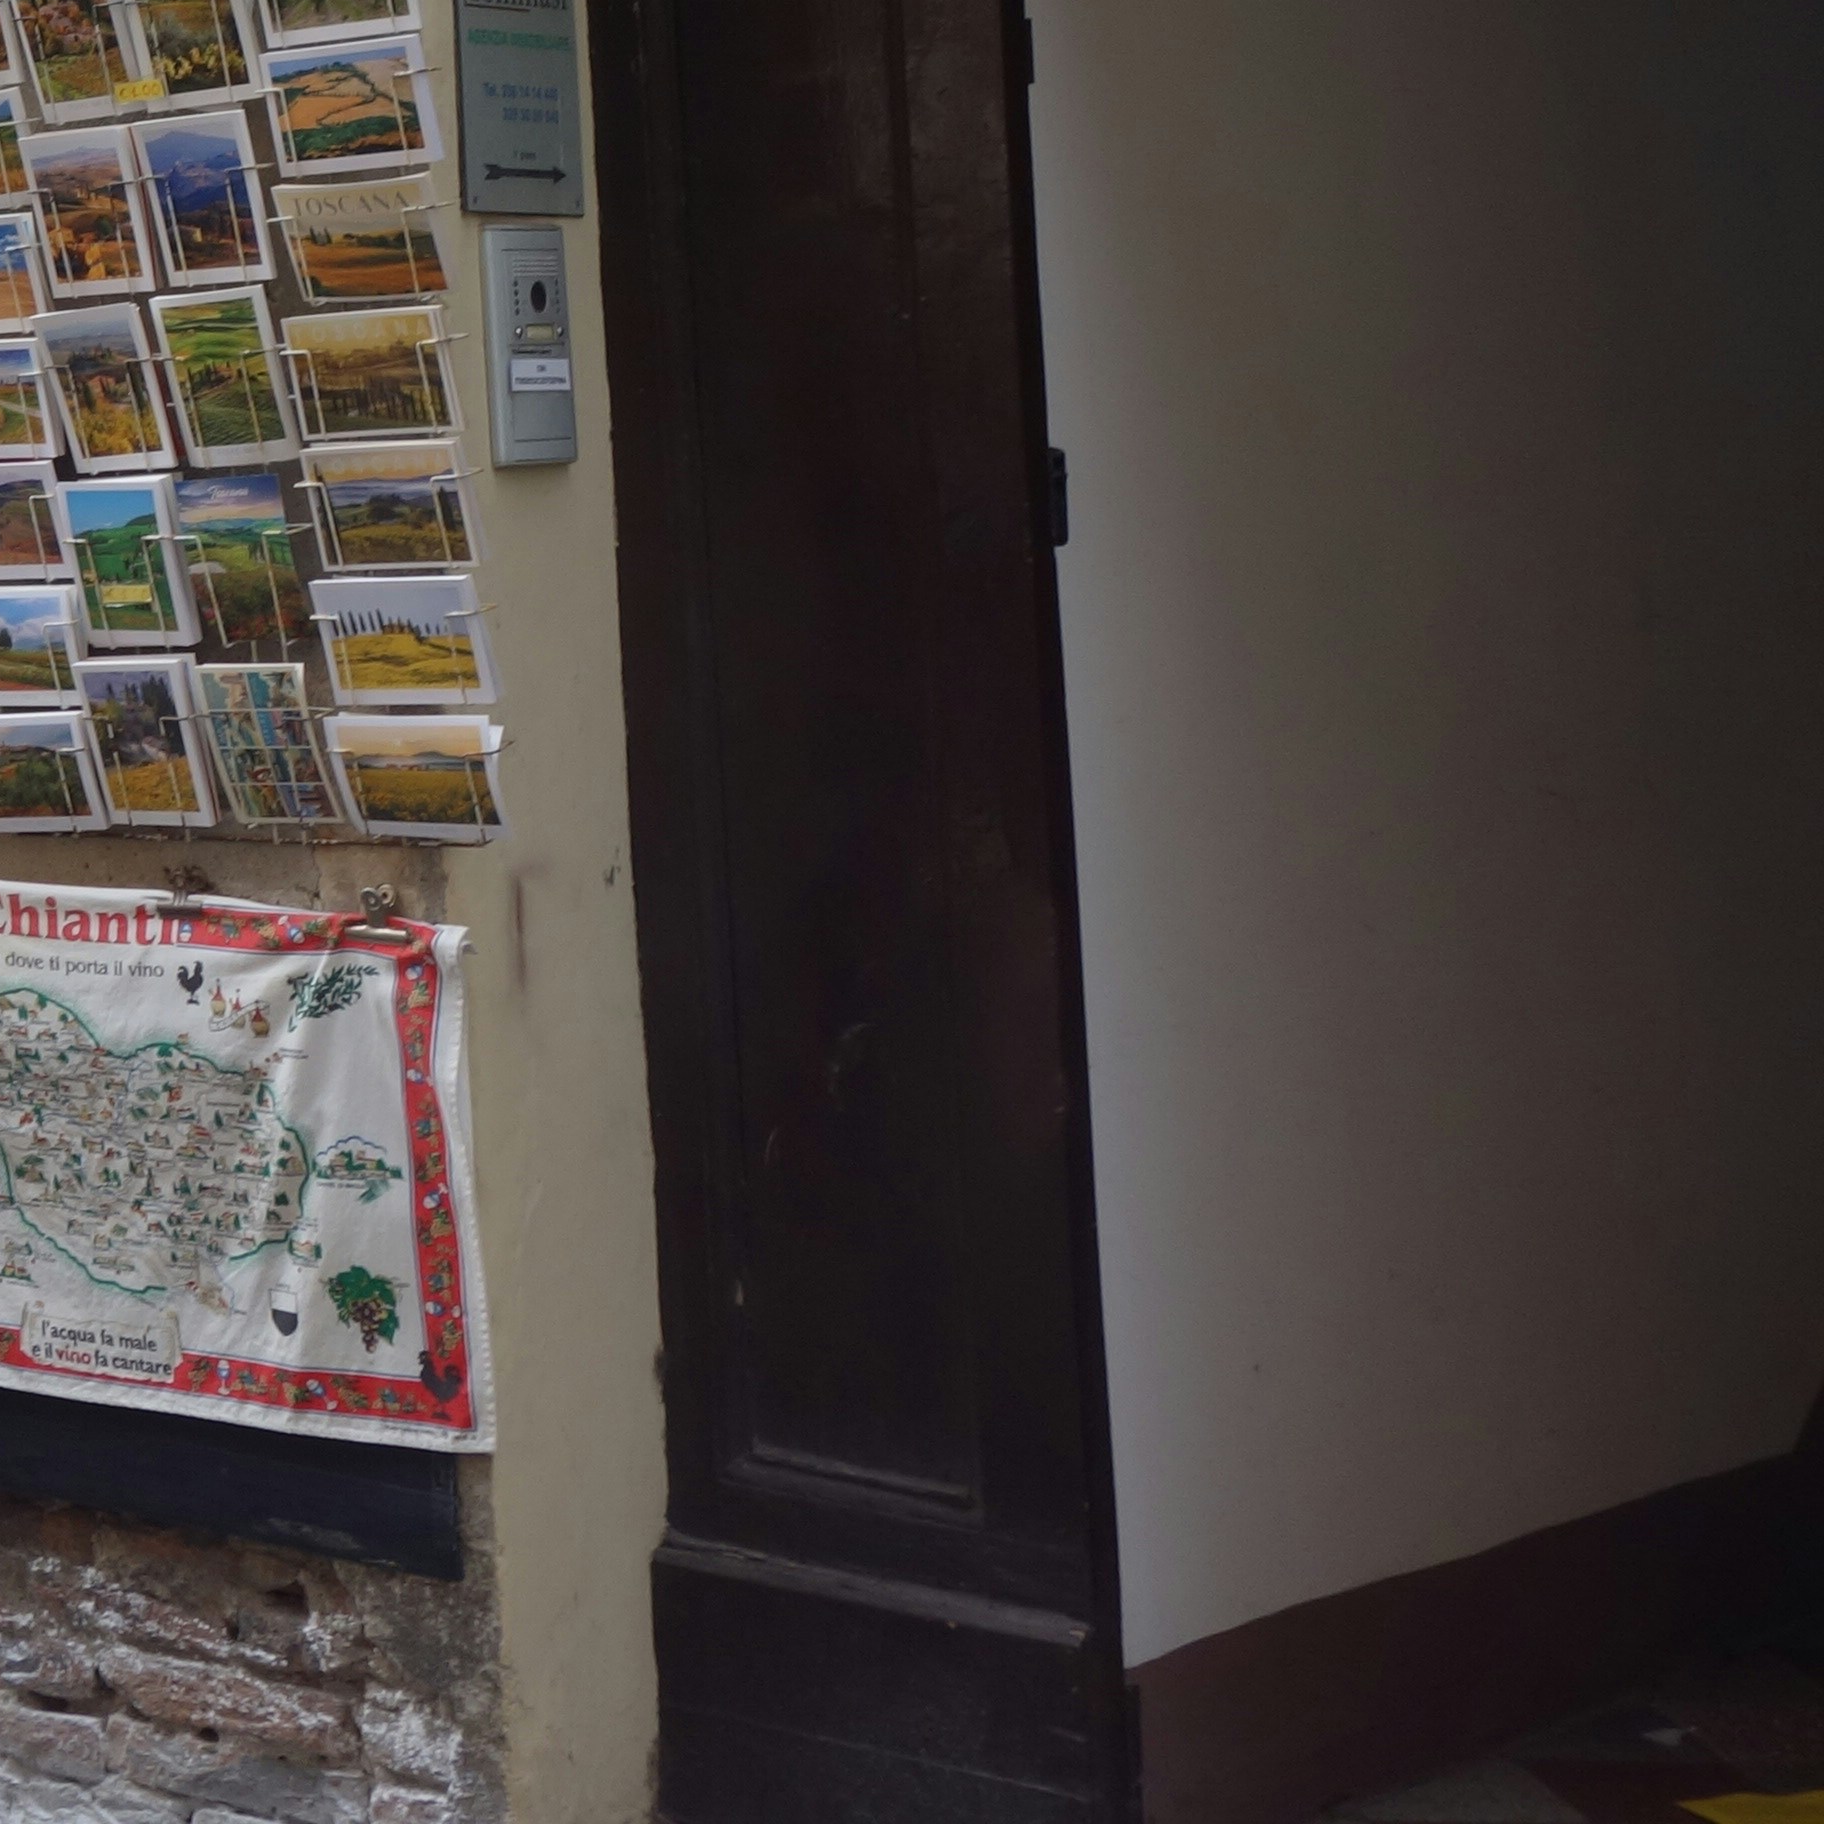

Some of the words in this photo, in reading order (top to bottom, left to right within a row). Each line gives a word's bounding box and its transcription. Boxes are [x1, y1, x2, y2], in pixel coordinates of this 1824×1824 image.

[294, 191, 410, 217] TOSCANA
[5, 950, 44, 970] dove
[49, 956, 60, 972] ti
[65, 959, 108, 977] porta
[114, 961, 123, 976] il
[128, 964, 165, 978] vino
[41, 1320, 96, 1347] l'acqua
[101, 1329, 115, 1347] fa
[119, 1335, 158, 1352] male
[32, 1345, 41, 1357] e
[44, 1343, 53, 1356] il
[55, 1345, 91, 1365] vino
[94, 1350, 108, 1367] fa
[112, 1356, 172, 1376] cantare
